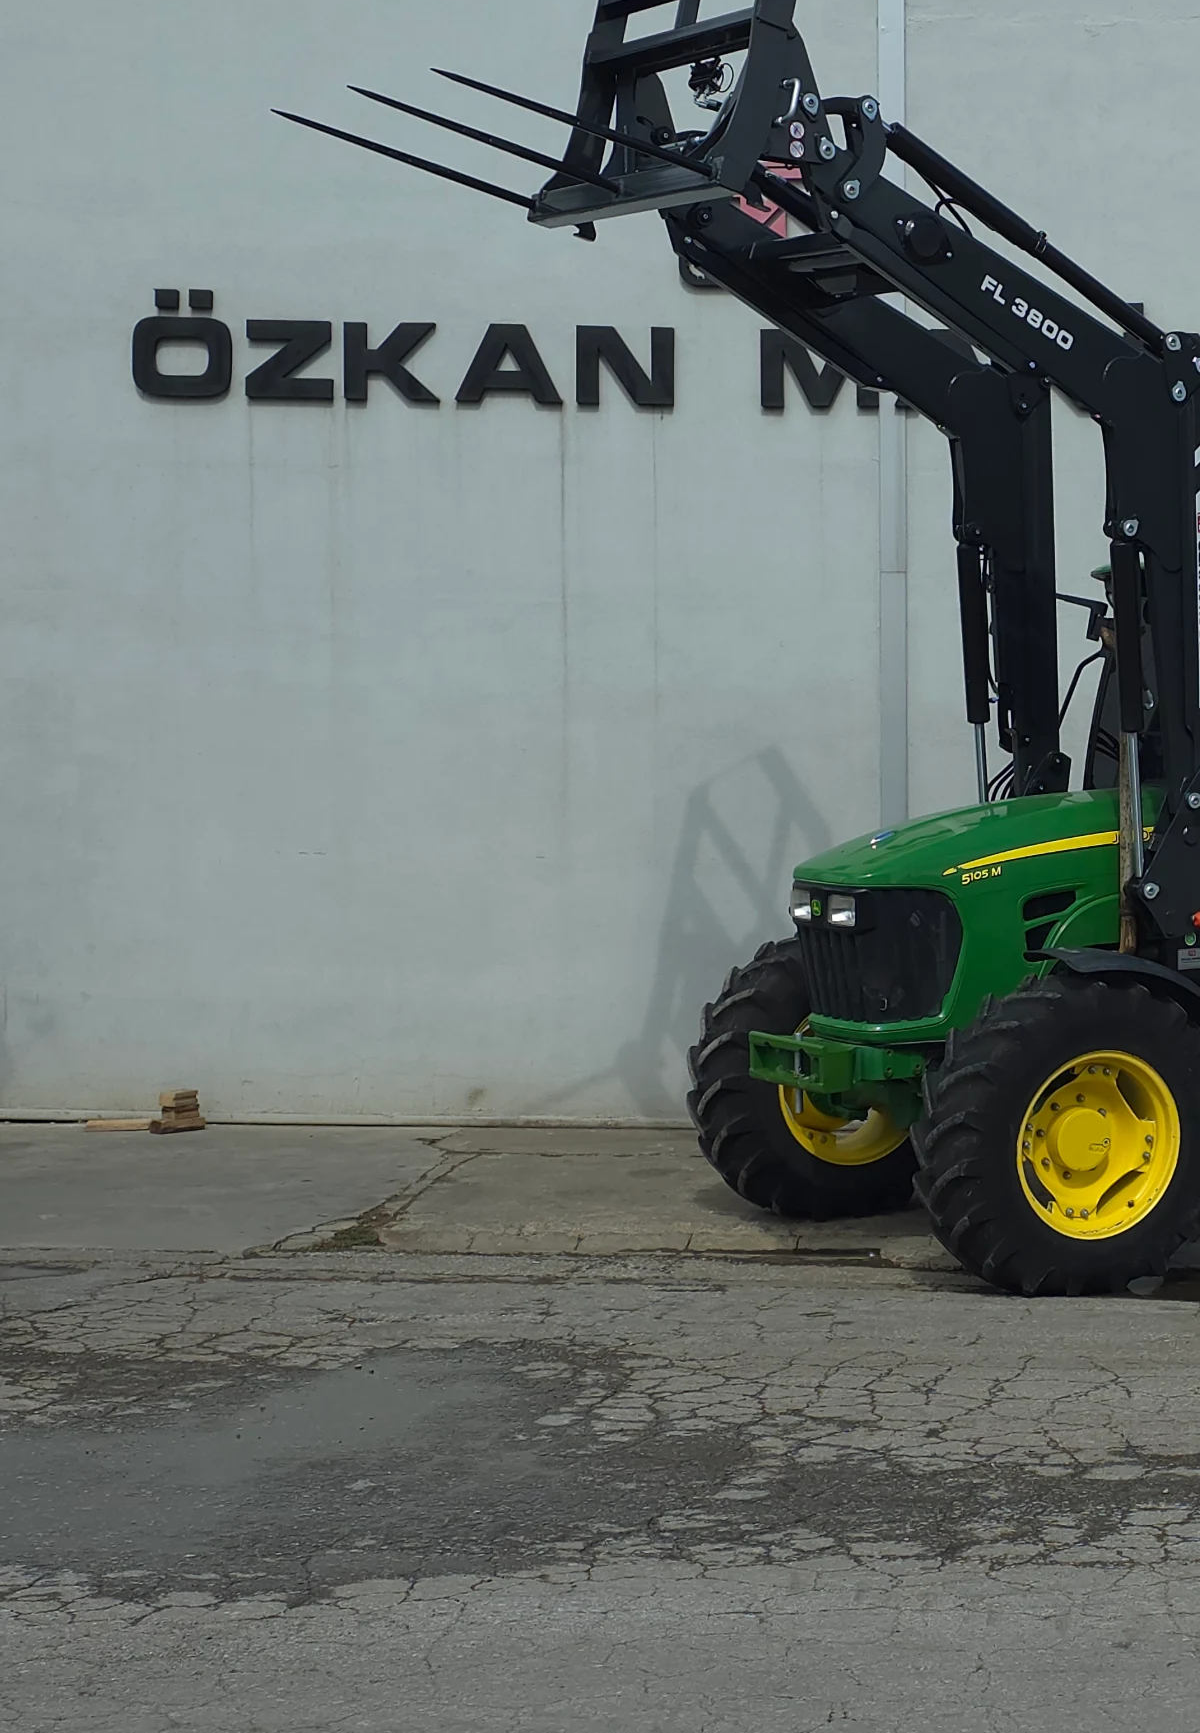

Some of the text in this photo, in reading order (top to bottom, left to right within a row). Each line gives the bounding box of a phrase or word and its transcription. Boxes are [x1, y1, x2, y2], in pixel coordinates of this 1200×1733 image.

[131, 288, 675, 407] ÖZKAN
[980, 274, 1074, 350] FL 3800
[961, 866, 1002, 885] 5105 M
